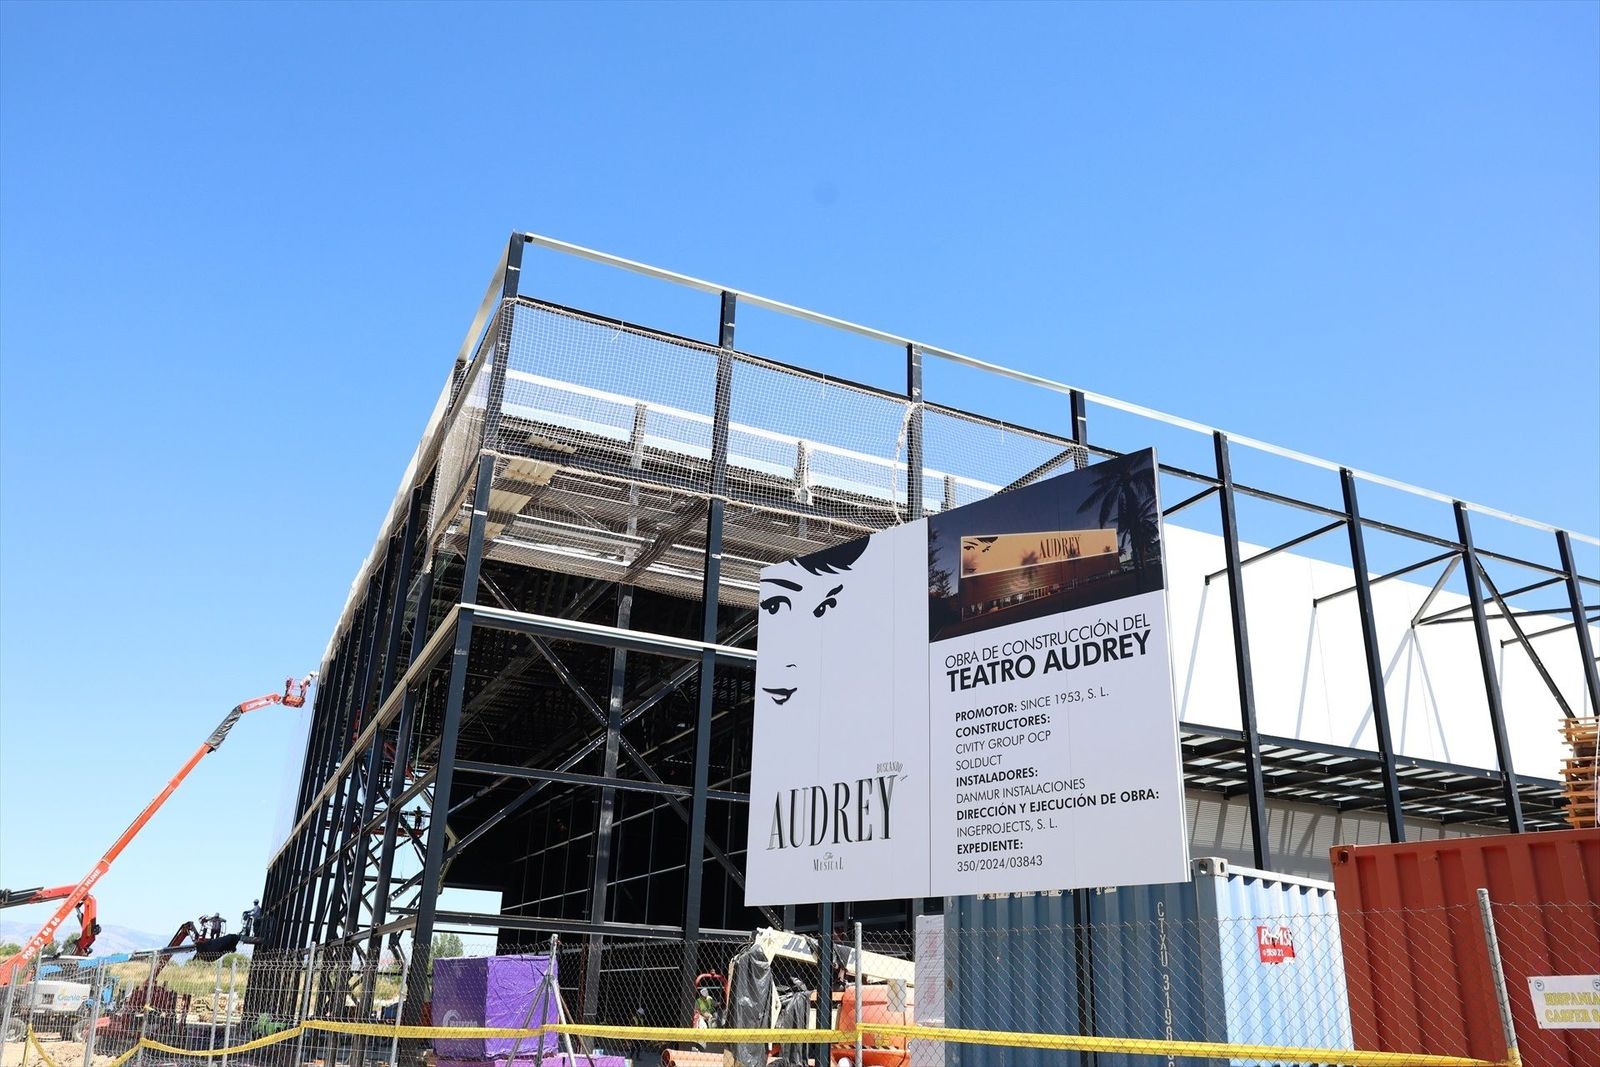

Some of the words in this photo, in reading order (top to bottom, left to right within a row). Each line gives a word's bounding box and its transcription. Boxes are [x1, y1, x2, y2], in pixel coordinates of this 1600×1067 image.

[1039, 536, 1081, 559] AUDREY
[945, 650, 980, 669] OBRA
[982, 646, 999, 662] DE
[1002, 619, 1119, 657] CONSTRUCCIÓN
[1123, 613, 1150, 633] DEL
[946, 655, 1036, 692] TEATRO
[1043, 630, 1152, 674] AUDREY
[955, 703, 1018, 722] PROMOTOR:
[1020, 697, 1051, 711] SINCE
[1055, 691, 1085, 705] 1953,
[1088, 688, 1097, 700] S.
[1100, 686, 1109, 697] L.
[955, 714, 1051, 738] CONSTRUCTORES:
[956, 741, 986, 754] CIVITY
[988, 735, 1025, 750] GROUP
[1028, 730, 1051, 743] OCP
[956, 755, 1002, 770] SOLDUCT
[956, 768, 1038, 787] INSTALADORES:
[956, 789, 1000, 803] DANMUR
[1003, 779, 1086, 798] INSTALACIONES
[766, 775, 898, 850] AUDREY
[957, 802, 1016, 820] DIRECCIÓN
[1020, 803, 1027, 814] Y
[1030, 793, 1097, 813] EJECUCIÓN
[1101, 792, 1116, 804] DE
[1122, 789, 1160, 802] OBRA:
[957, 820, 1034, 838] INGEPROJECTS,
[1037, 819, 1046, 829] S.
[1049, 818, 1058, 828] L.
[957, 840, 1023, 854] EXPEDIENTE:
[957, 855, 1043, 872] 350/2024/03843
